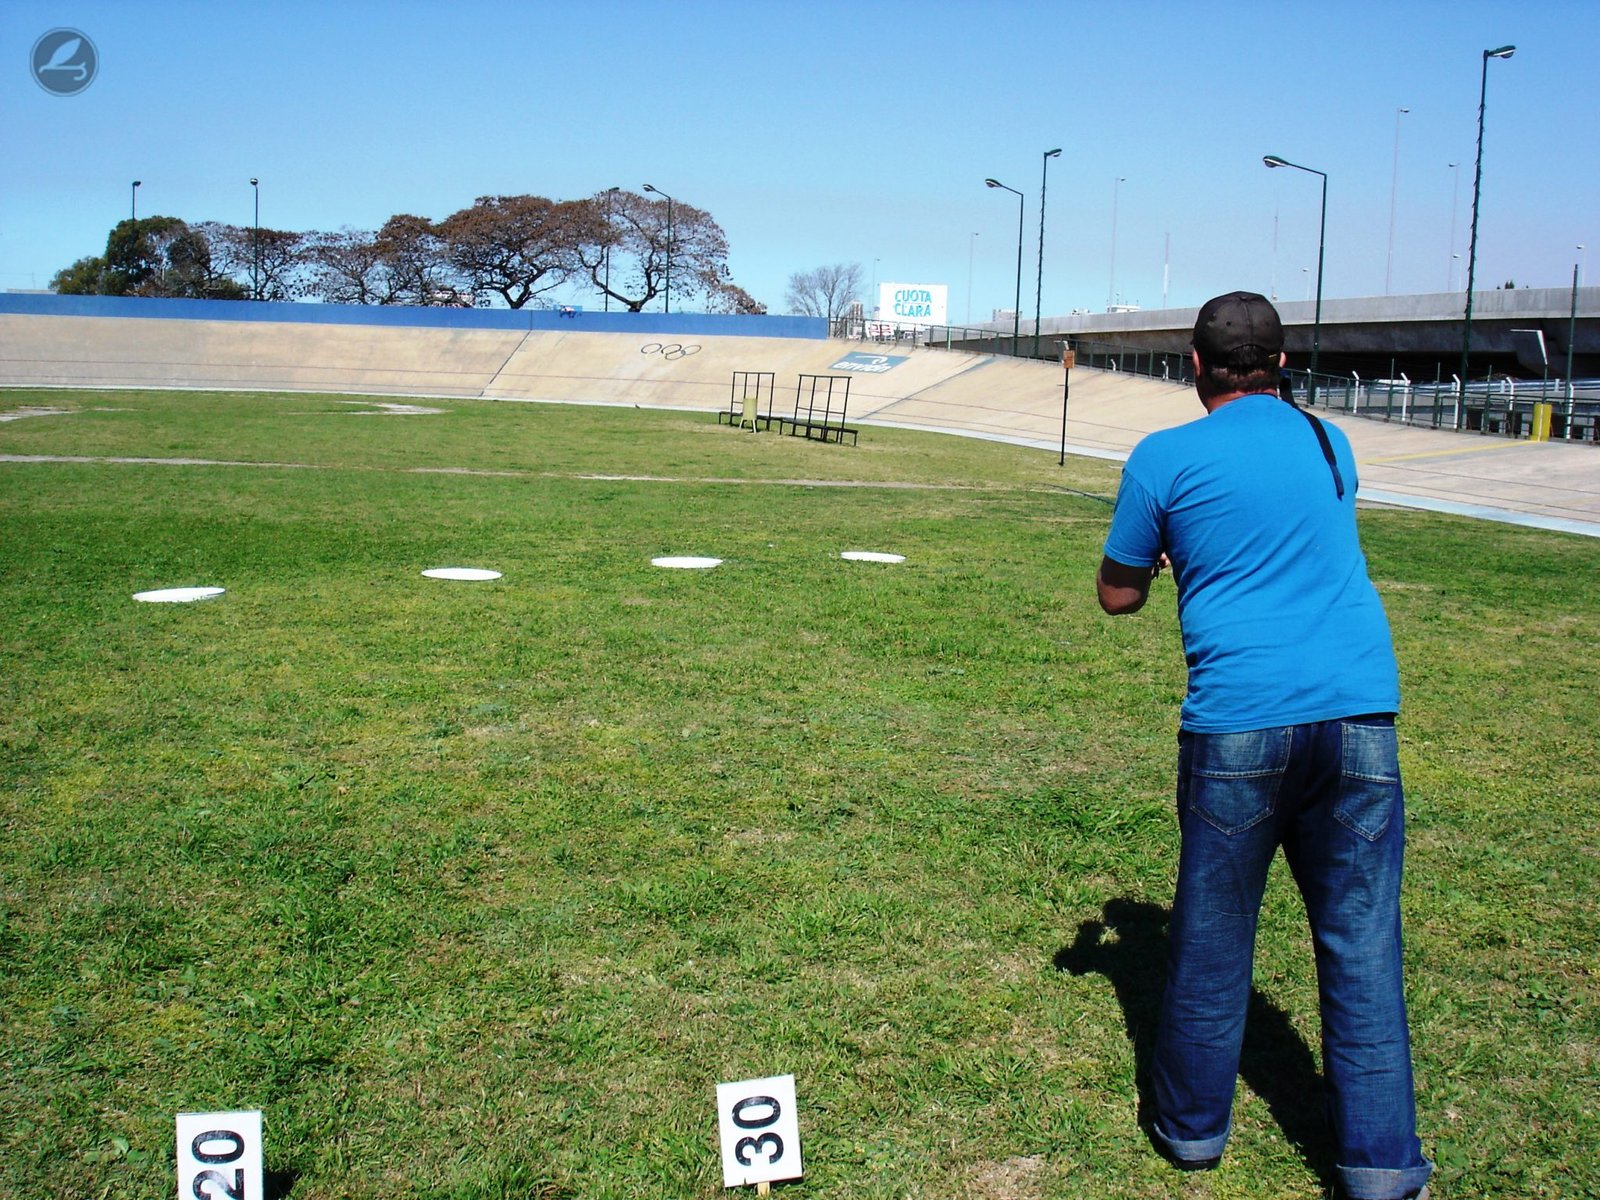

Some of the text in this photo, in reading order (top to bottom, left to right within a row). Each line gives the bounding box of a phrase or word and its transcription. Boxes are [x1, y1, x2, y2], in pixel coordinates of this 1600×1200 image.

[895, 289, 932, 303] CUOTA
[895, 303, 931, 317] CLARA
[731, 1095, 784, 1167] 30
[191, 1129, 245, 1200] 20
